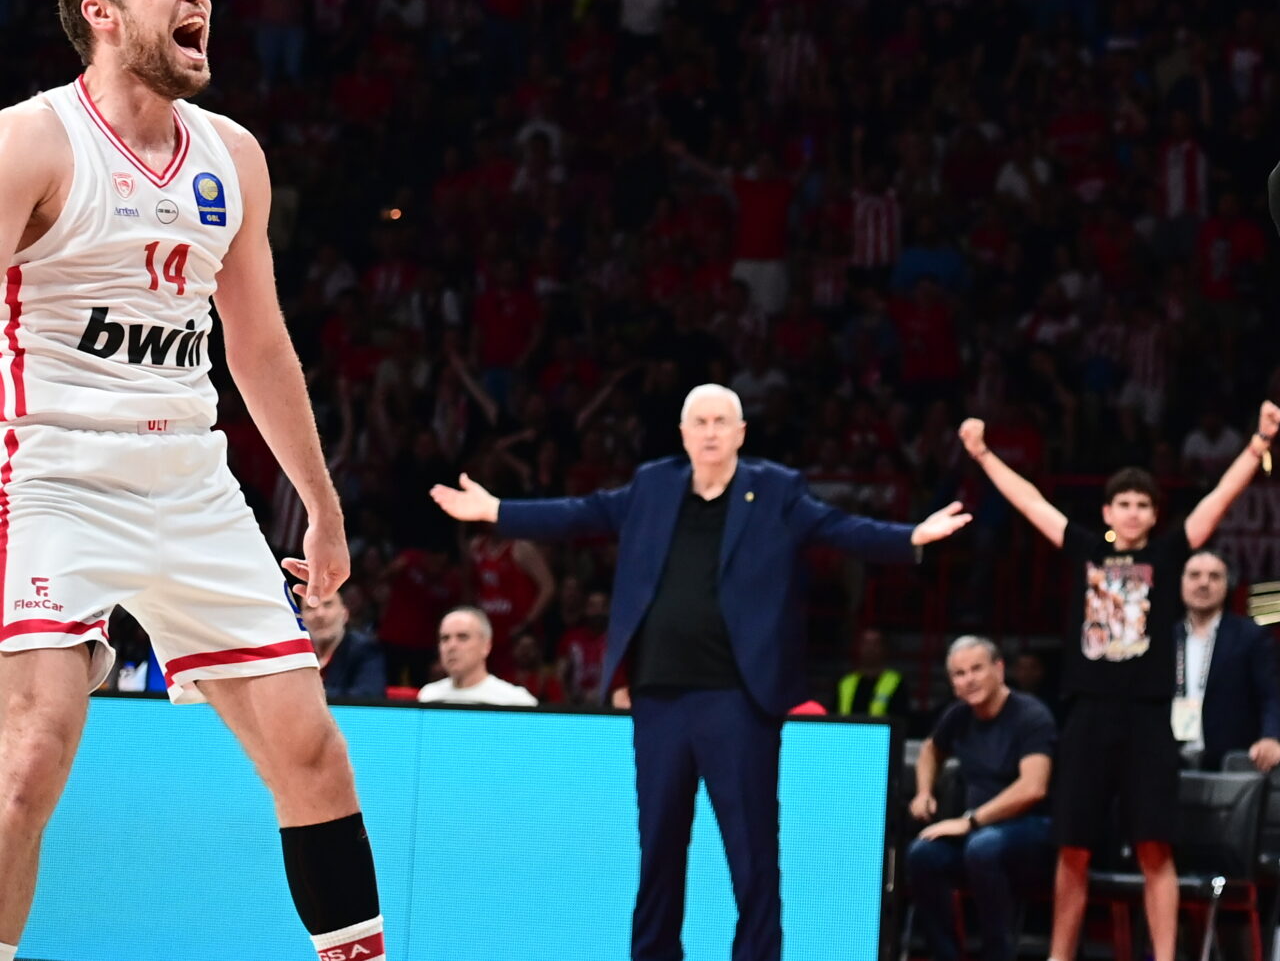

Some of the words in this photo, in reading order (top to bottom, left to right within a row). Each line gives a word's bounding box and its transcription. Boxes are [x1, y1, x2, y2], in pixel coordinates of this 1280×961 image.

[144, 241, 192, 296] 14
[77, 306, 205, 368] bwin
[14, 598, 65, 613] FlexCar
